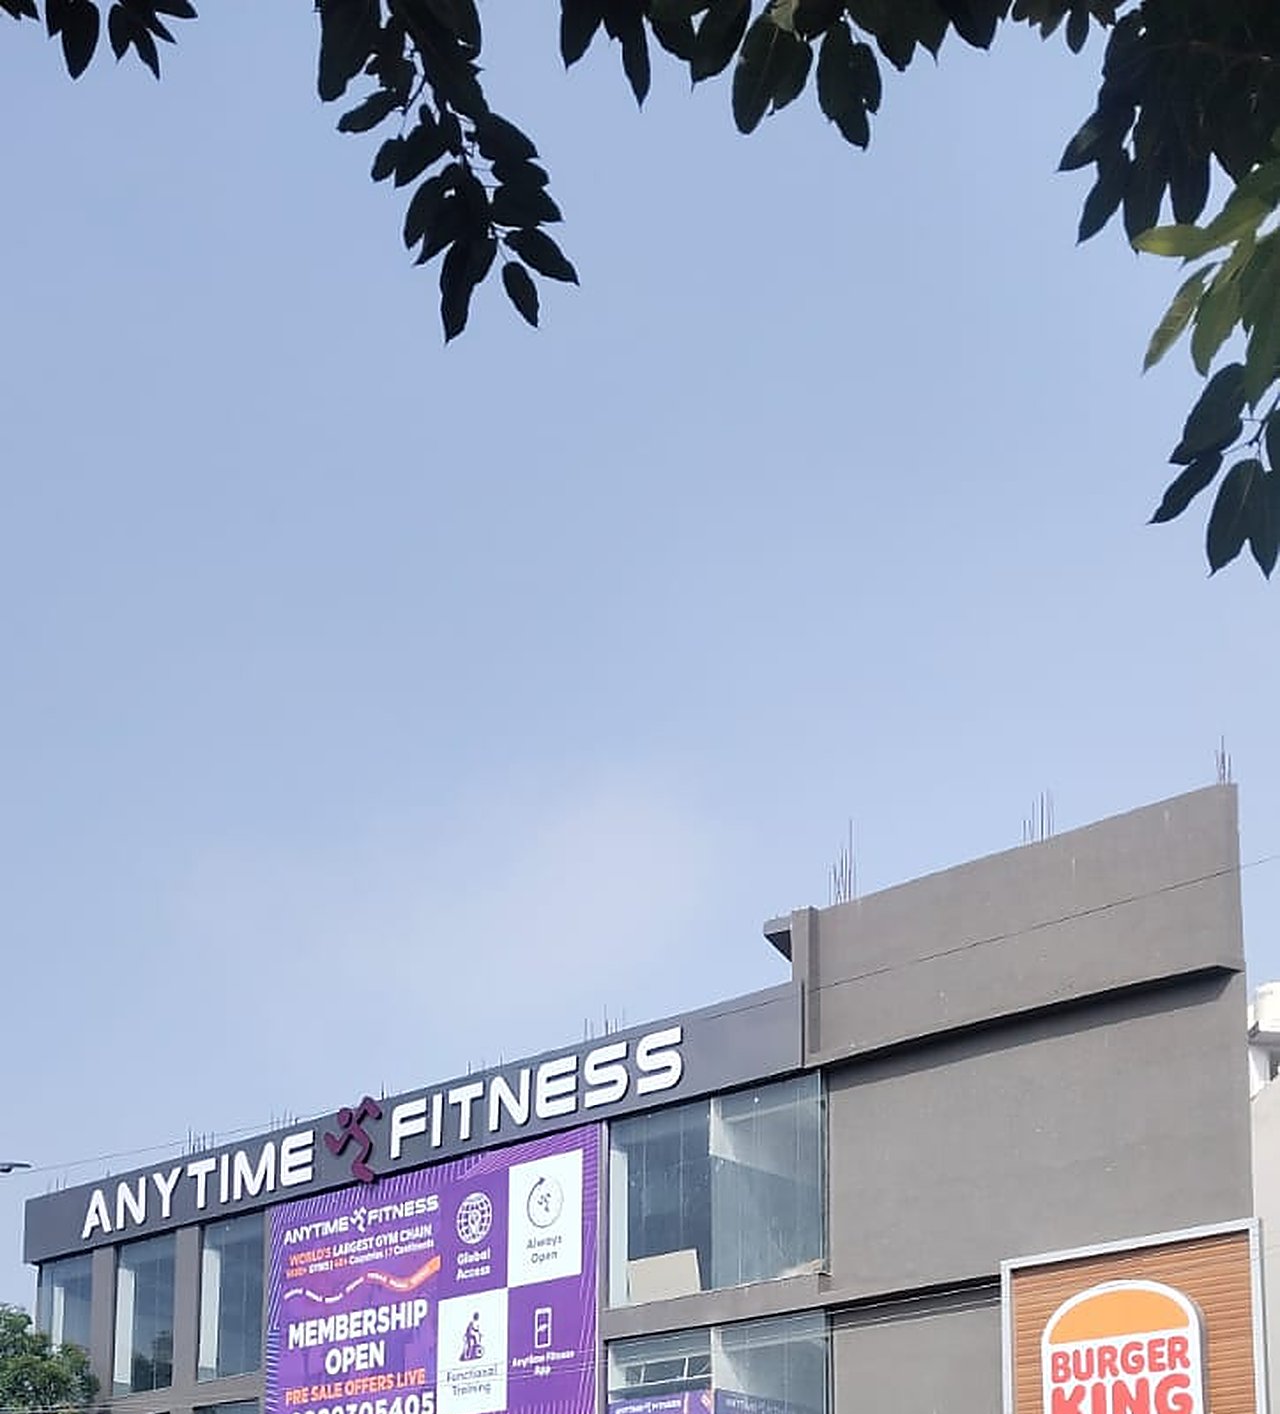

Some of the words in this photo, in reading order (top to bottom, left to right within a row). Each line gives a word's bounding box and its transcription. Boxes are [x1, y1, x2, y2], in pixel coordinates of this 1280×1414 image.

[82, 1130, 314, 1239] ANYTIME
[390, 1026, 682, 1159] FITNESS
[284, 1216, 349, 1245] ANYTIME
[367, 1194, 439, 1225] FITNESS
[333, 1237, 374, 1257] LARGEST
[375, 1230, 399, 1248] GYM
[400, 1223, 432, 1242] CHAIN
[457, 1247, 491, 1265] Global
[526, 1235, 563, 1249] Always
[456, 1265, 491, 1281] Access
[531, 1251, 558, 1264] Open
[288, 1299, 428, 1350] MEMBERSHIP
[325, 1340, 385, 1375] OPEN
[446, 1364, 498, 1382] Functional
[1051, 1336, 1191, 1383] BURGER
[286, 1388, 308, 1406] PRE
[311, 1382, 344, 1401] SALE
[345, 1373, 394, 1395] OFFERS
[397, 1368, 426, 1387] LIVE
[452, 1383, 492, 1397] Training
